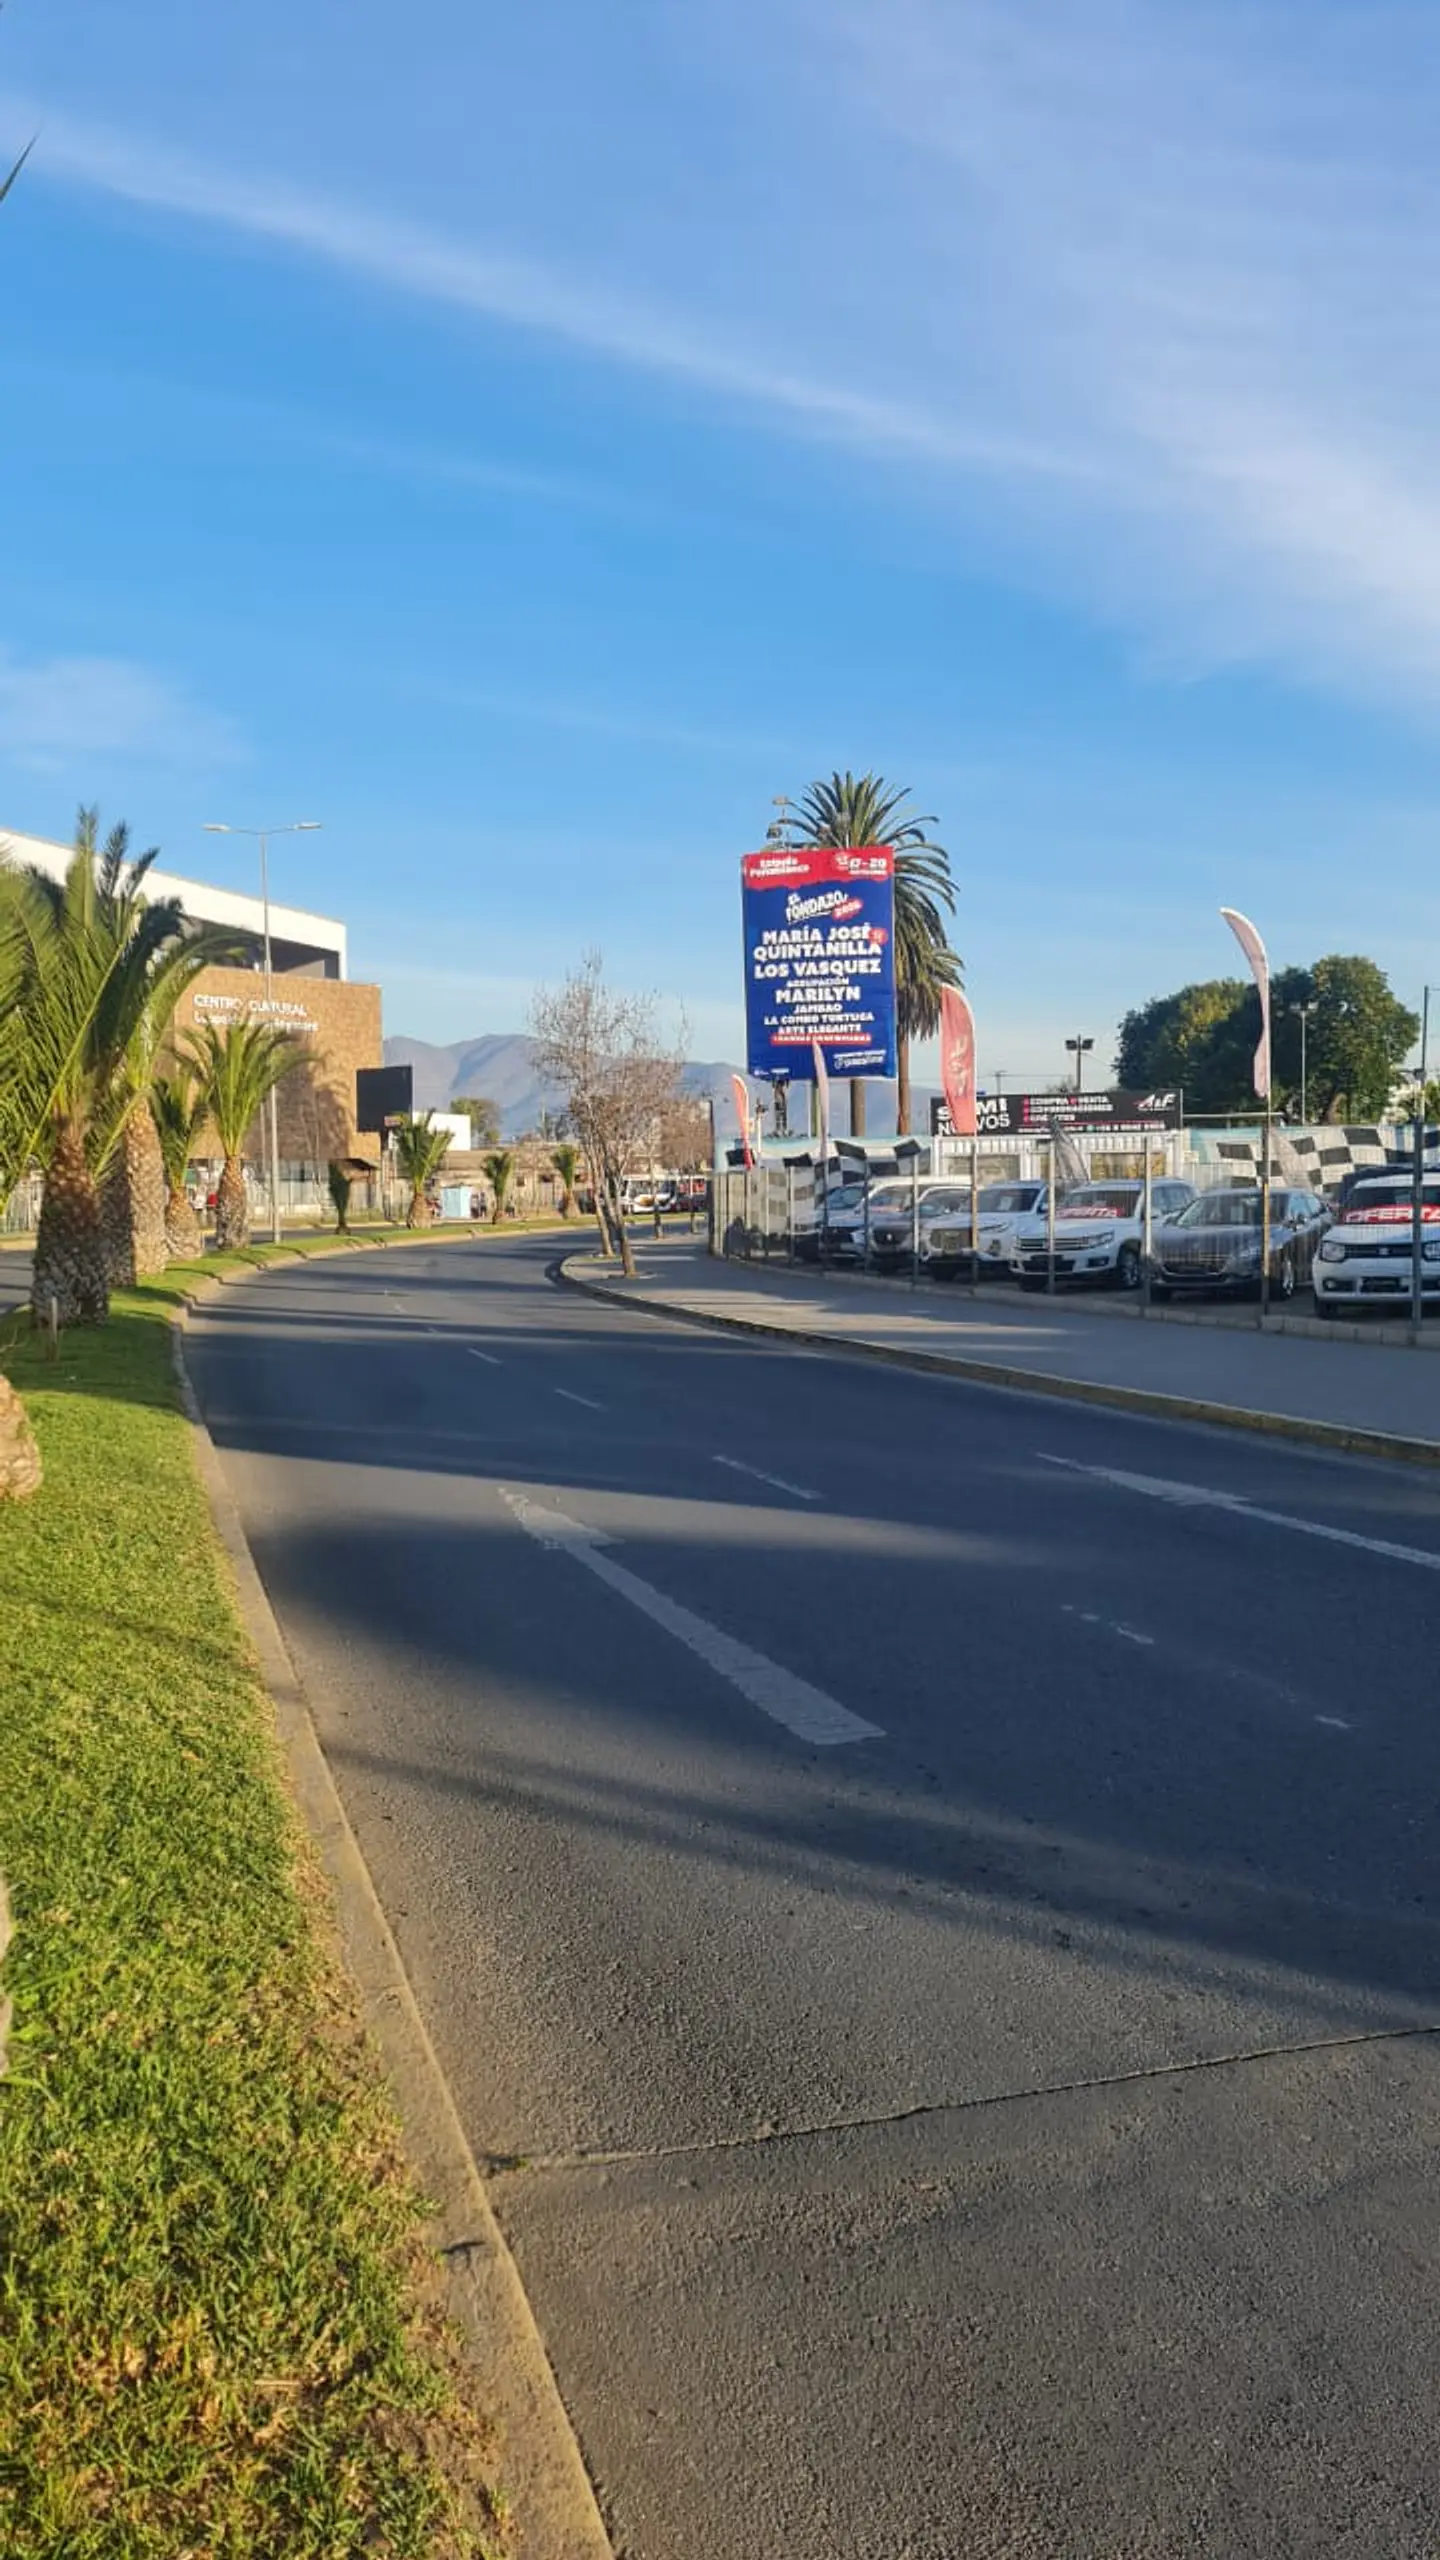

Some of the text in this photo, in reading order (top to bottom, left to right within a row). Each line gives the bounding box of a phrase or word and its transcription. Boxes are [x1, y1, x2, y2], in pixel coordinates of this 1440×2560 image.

[762, 924, 822, 945] MARÍA
[828, 922, 870, 941] JOSÉ
[754, 940, 882, 962] QUINTANILLA
[754, 958, 881, 979] LOS VASQUEZ
[194, 994, 243, 1010] CENTRO
[775, 986, 861, 1004] MARILYN
[794, 1003, 843, 1014] JAMBAO
[764, 1016, 779, 1025] LA
[936, 1097, 1008, 1121] SMI
[937, 1113, 1011, 1136] NVOS
